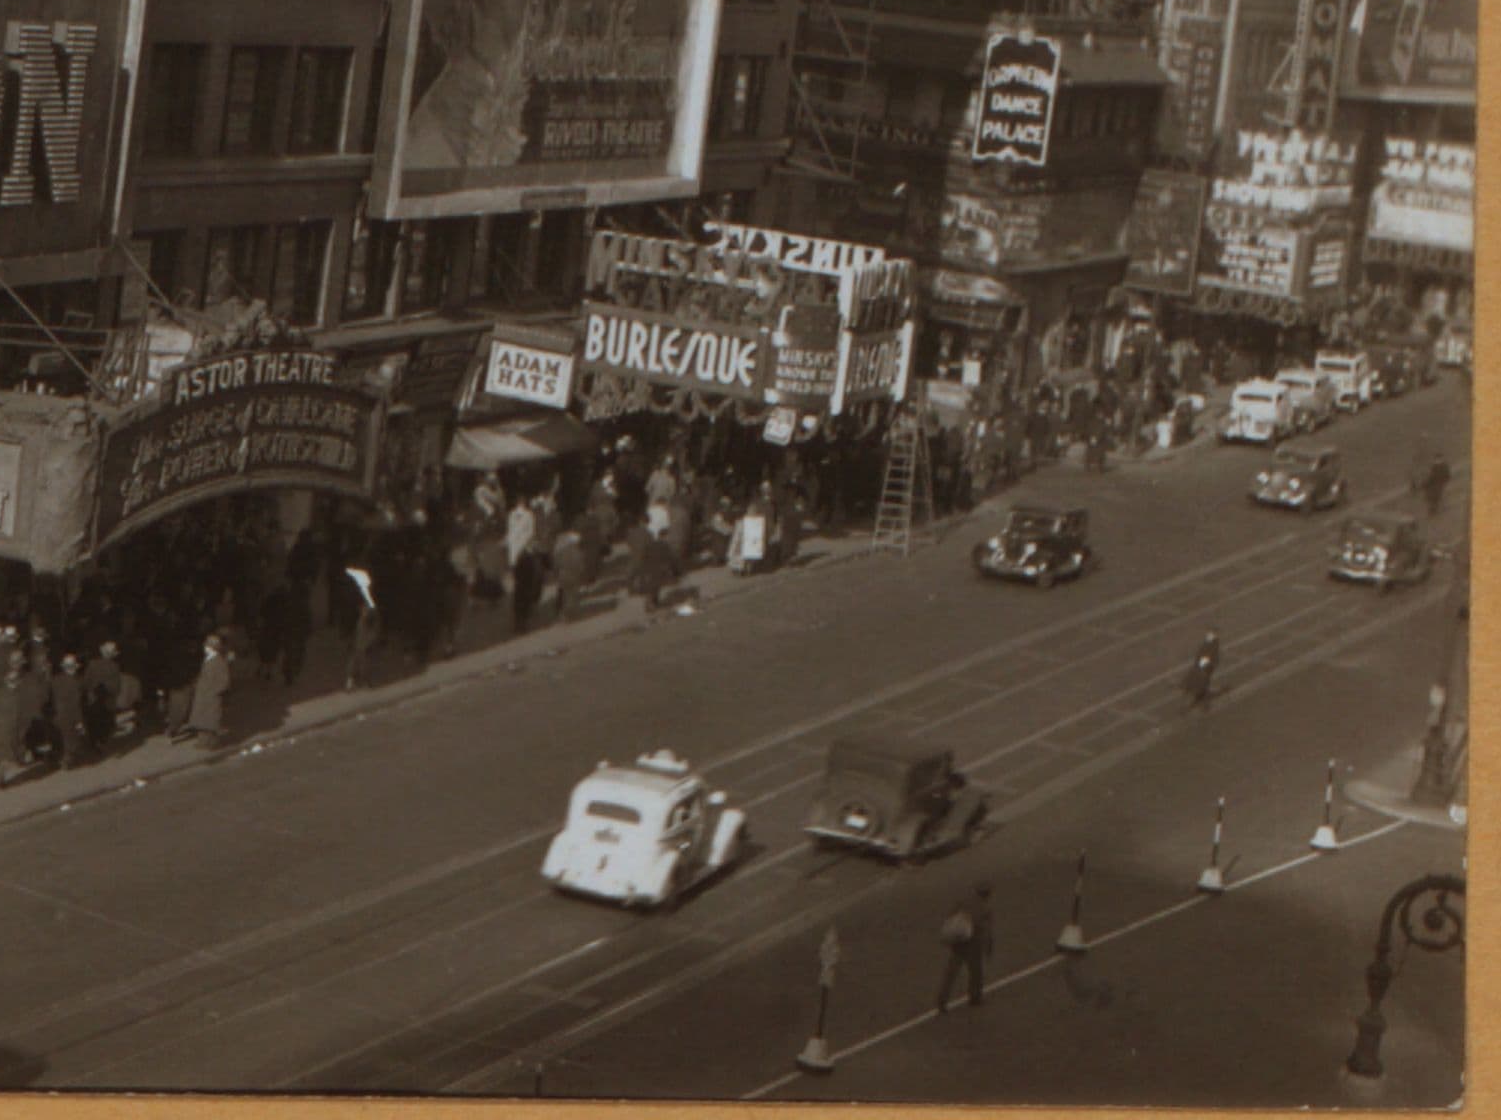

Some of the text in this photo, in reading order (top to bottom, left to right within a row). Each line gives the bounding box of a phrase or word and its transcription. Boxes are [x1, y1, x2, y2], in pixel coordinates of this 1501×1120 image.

[991, 91, 1044, 117] DANCE
[601, 120, 664, 147] THEATRE
[981, 119, 1045, 146] PALACE
[497, 350, 561, 378] ADAM
[584, 312, 758, 388] BURLESQUE
[174, 351, 336, 407] ASTOR THEATRE
[496, 367, 558, 395] HATS
